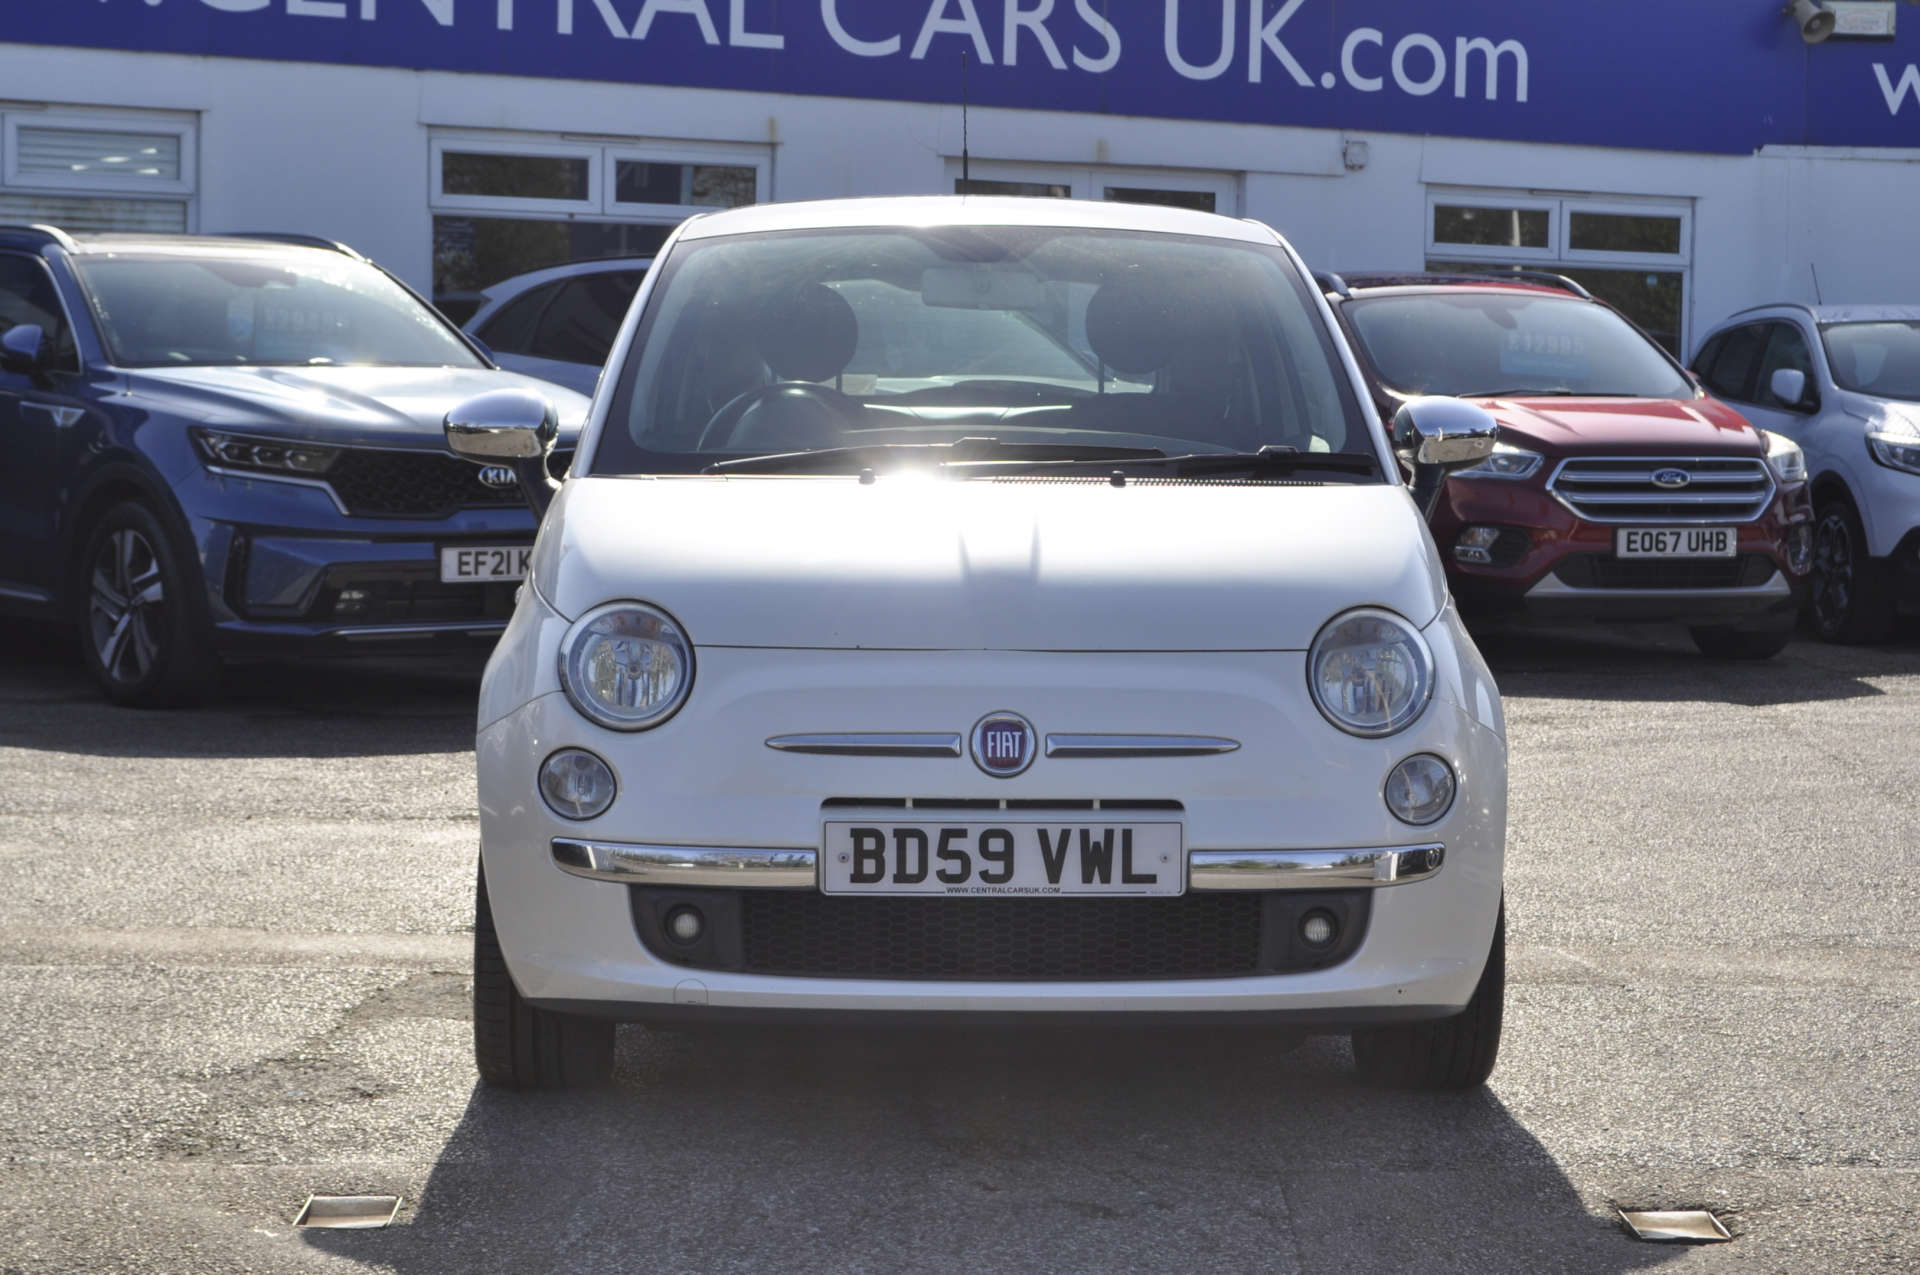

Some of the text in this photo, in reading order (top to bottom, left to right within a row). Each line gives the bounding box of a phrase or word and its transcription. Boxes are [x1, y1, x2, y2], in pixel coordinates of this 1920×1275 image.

[820, 0, 1122, 73] CARS
[1164, 0, 1529, 102] UK.com
[486, 468, 518, 484] KIA
[1626, 531, 1727, 553] EO67 UHB
[457, 550, 511, 576] EF21
[987, 731, 1022, 758] FIAT
[849, 828, 1158, 885] BD59 VWL
[946, 886, 1062, 895] WWW.CENTRALCARSUK.COM
